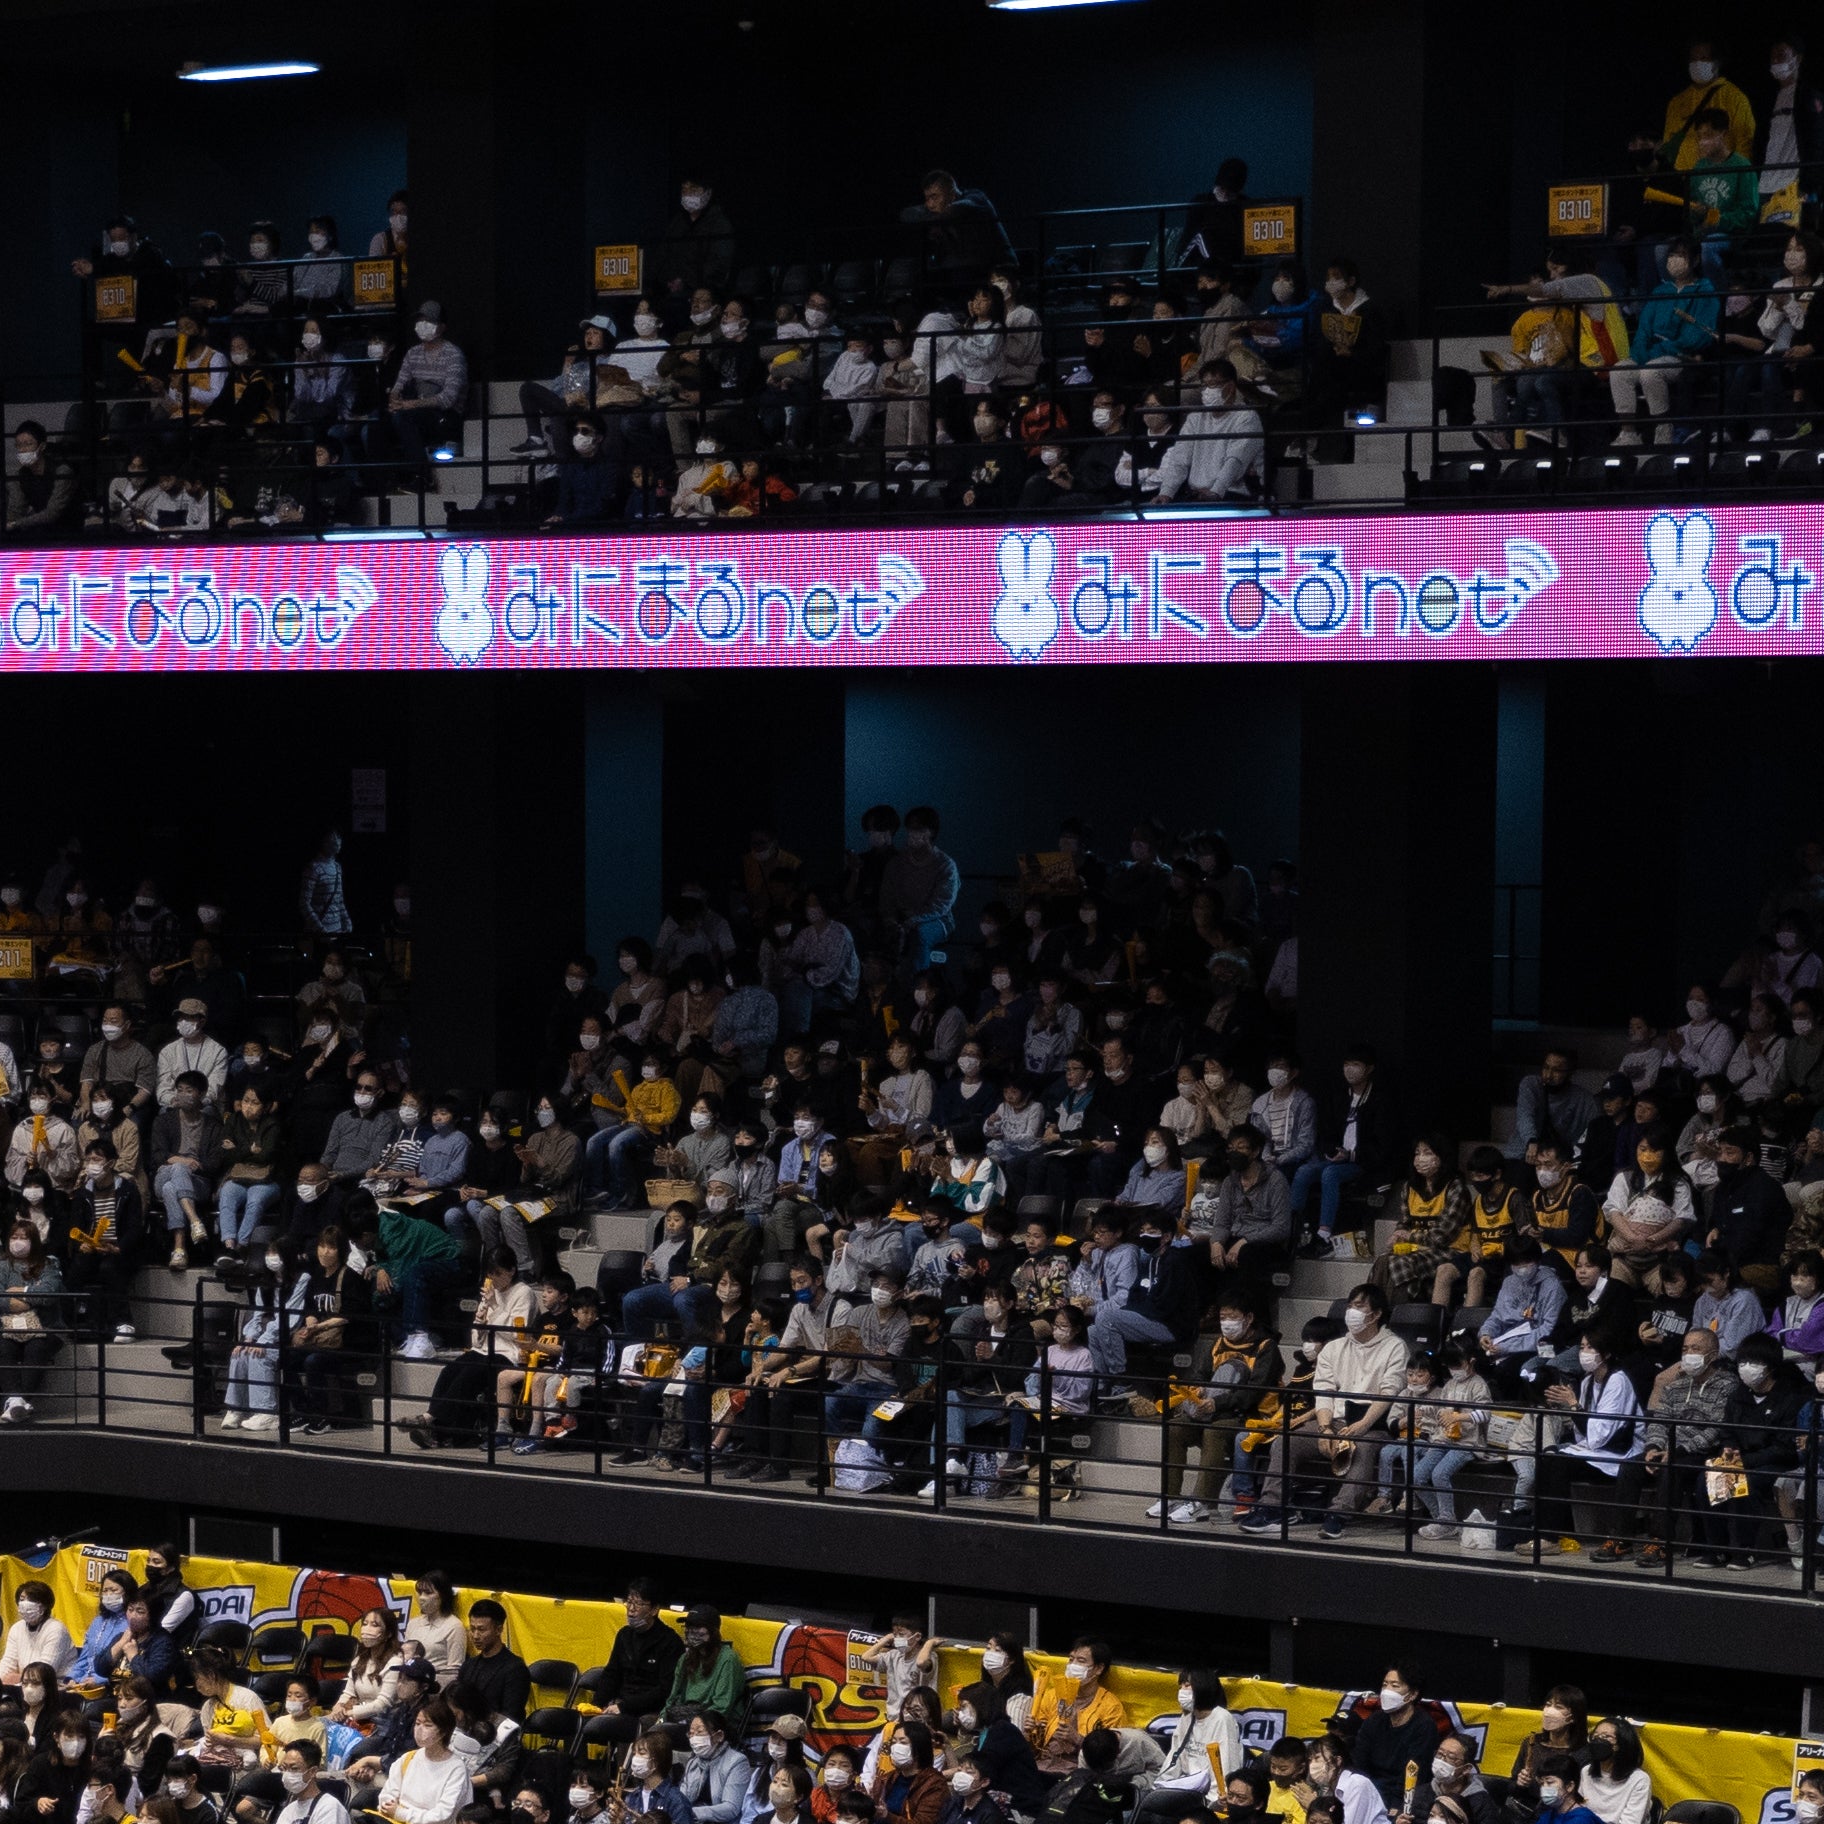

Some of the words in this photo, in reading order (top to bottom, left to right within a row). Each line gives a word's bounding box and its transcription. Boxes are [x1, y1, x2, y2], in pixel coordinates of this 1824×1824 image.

[11, 565, 349, 651] みにまるnet
[503, 554, 896, 646] みにまるnet
[1071, 541, 1521, 639] みにまるnet
